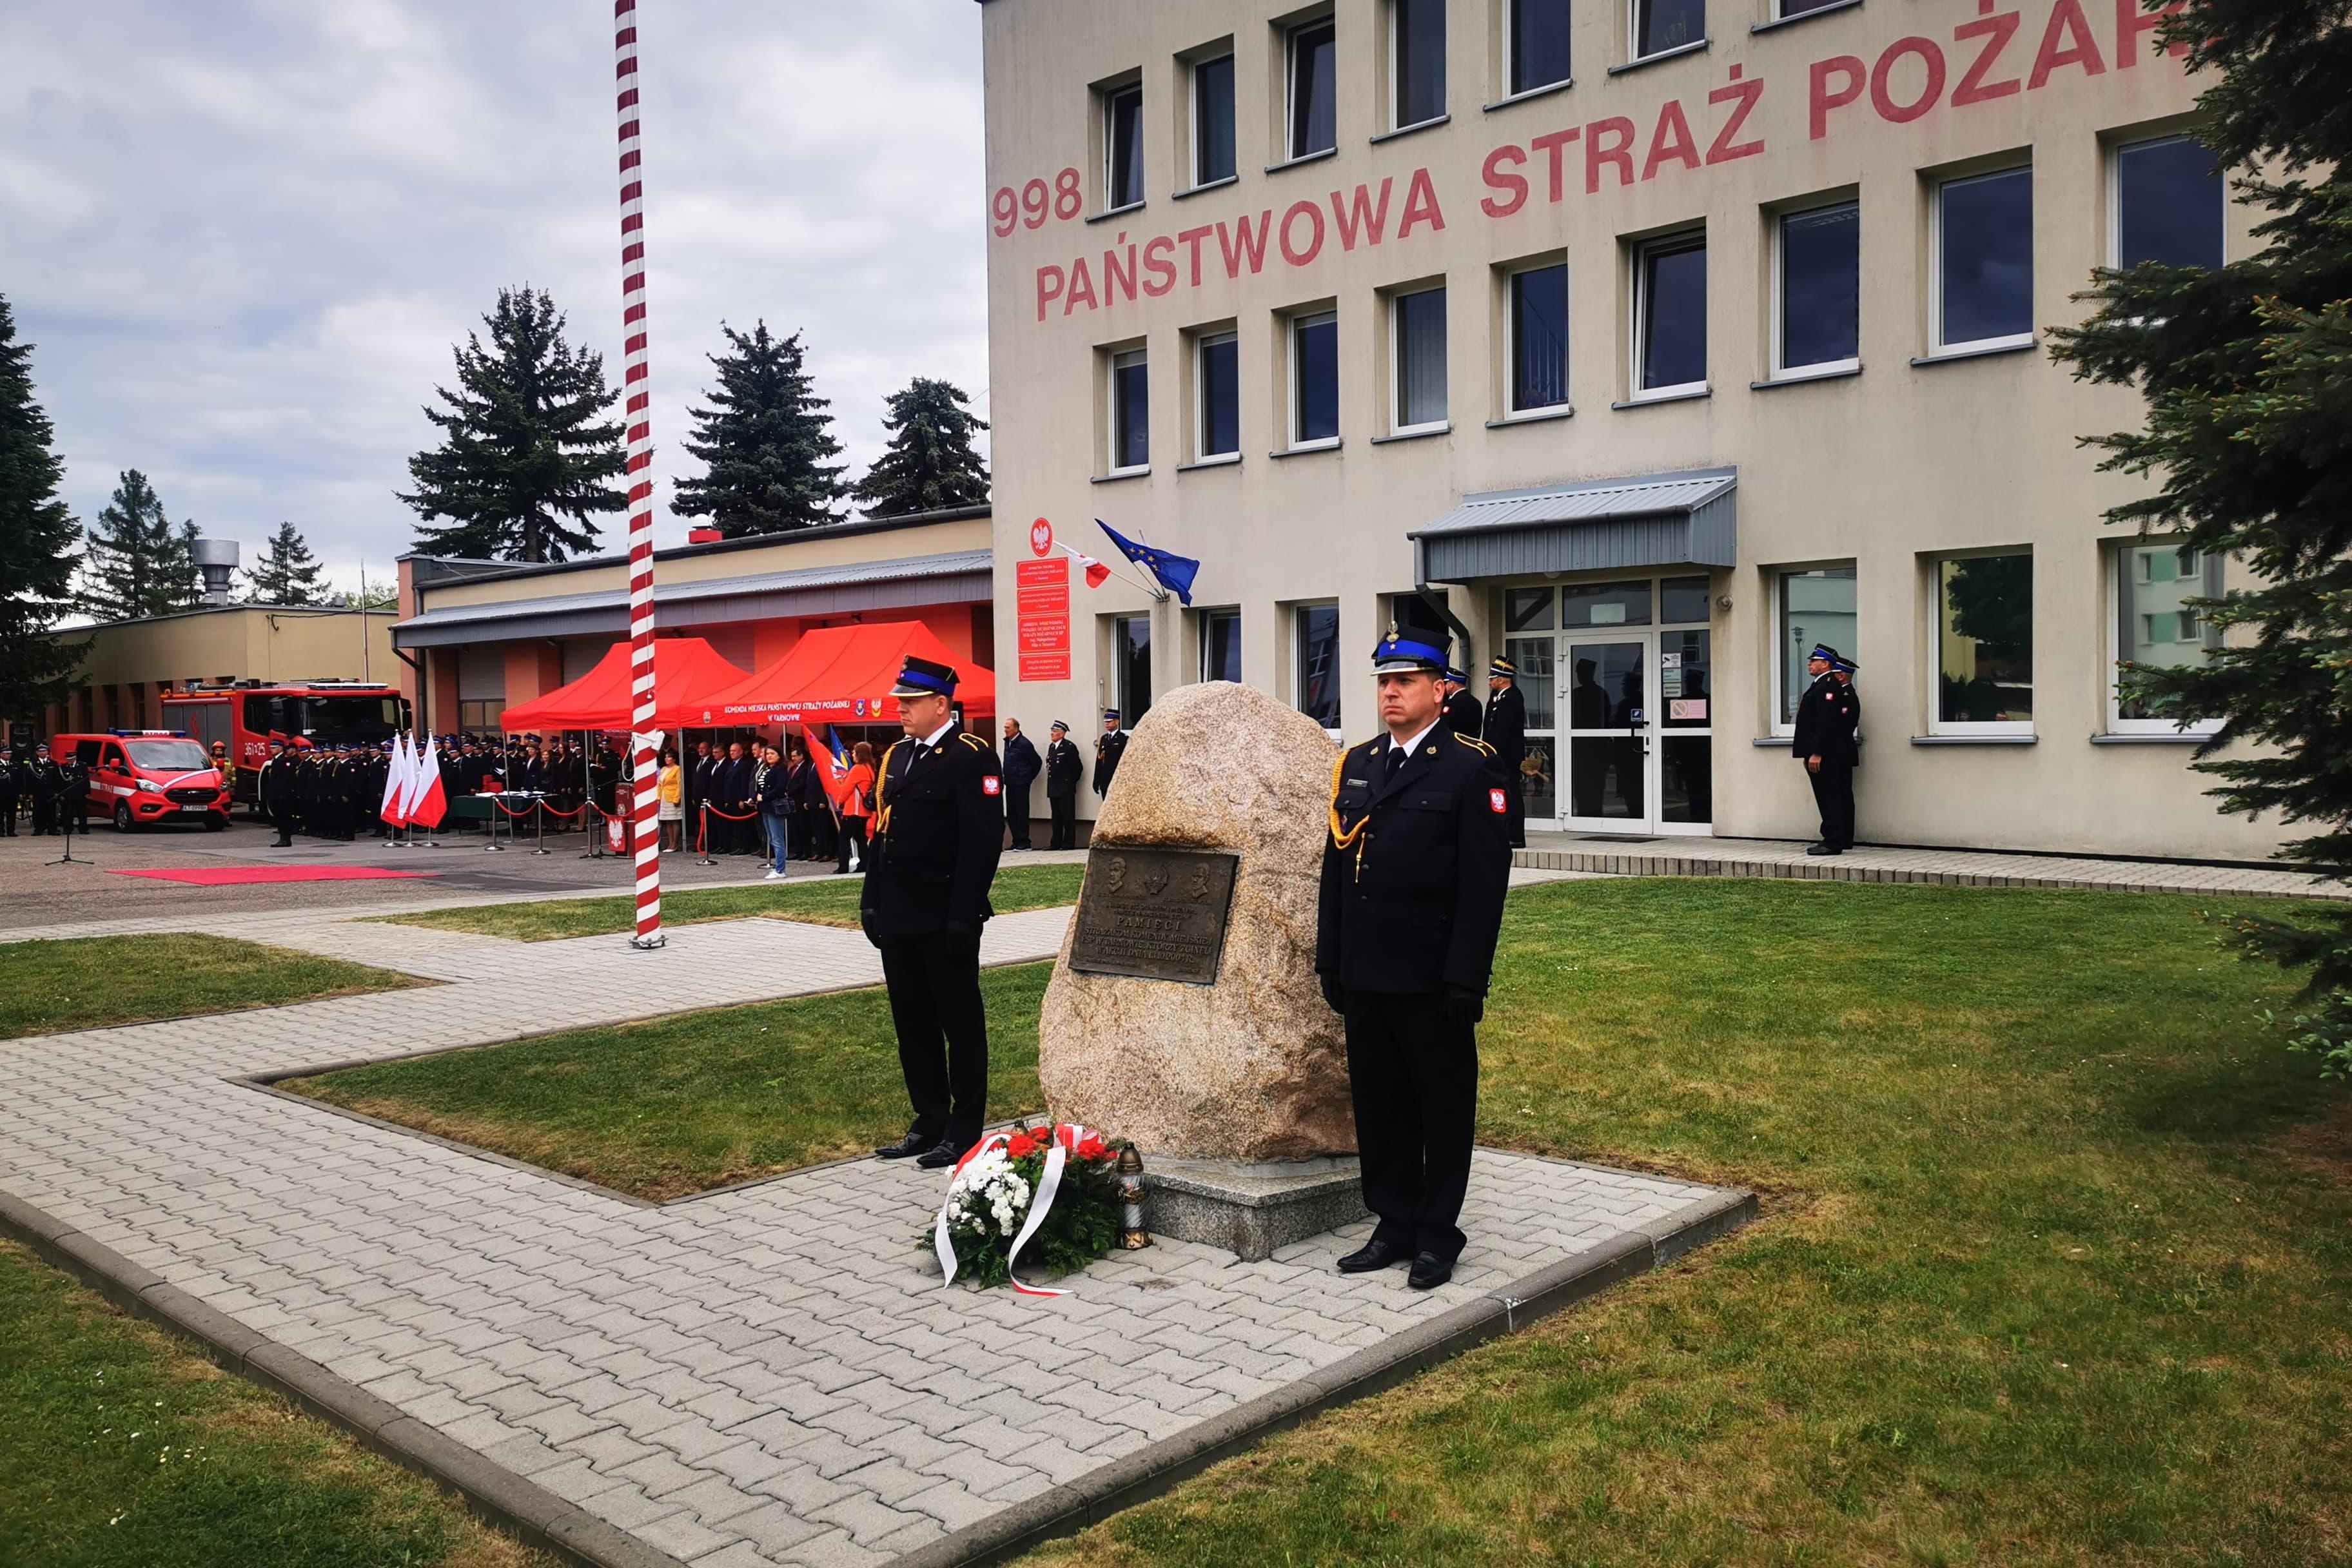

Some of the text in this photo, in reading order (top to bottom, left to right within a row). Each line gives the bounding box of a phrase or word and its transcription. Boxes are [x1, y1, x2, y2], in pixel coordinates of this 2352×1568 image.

[1035, 0, 2224, 322] PAŃSTWOWA STRAŻ POŻAR
[992, 167, 1083, 238] 998
[747, 704, 767, 712] MIEJSKA
[802, 700, 821, 710] STRAŻY
[822, 700, 850, 709] POŻARNEJ
